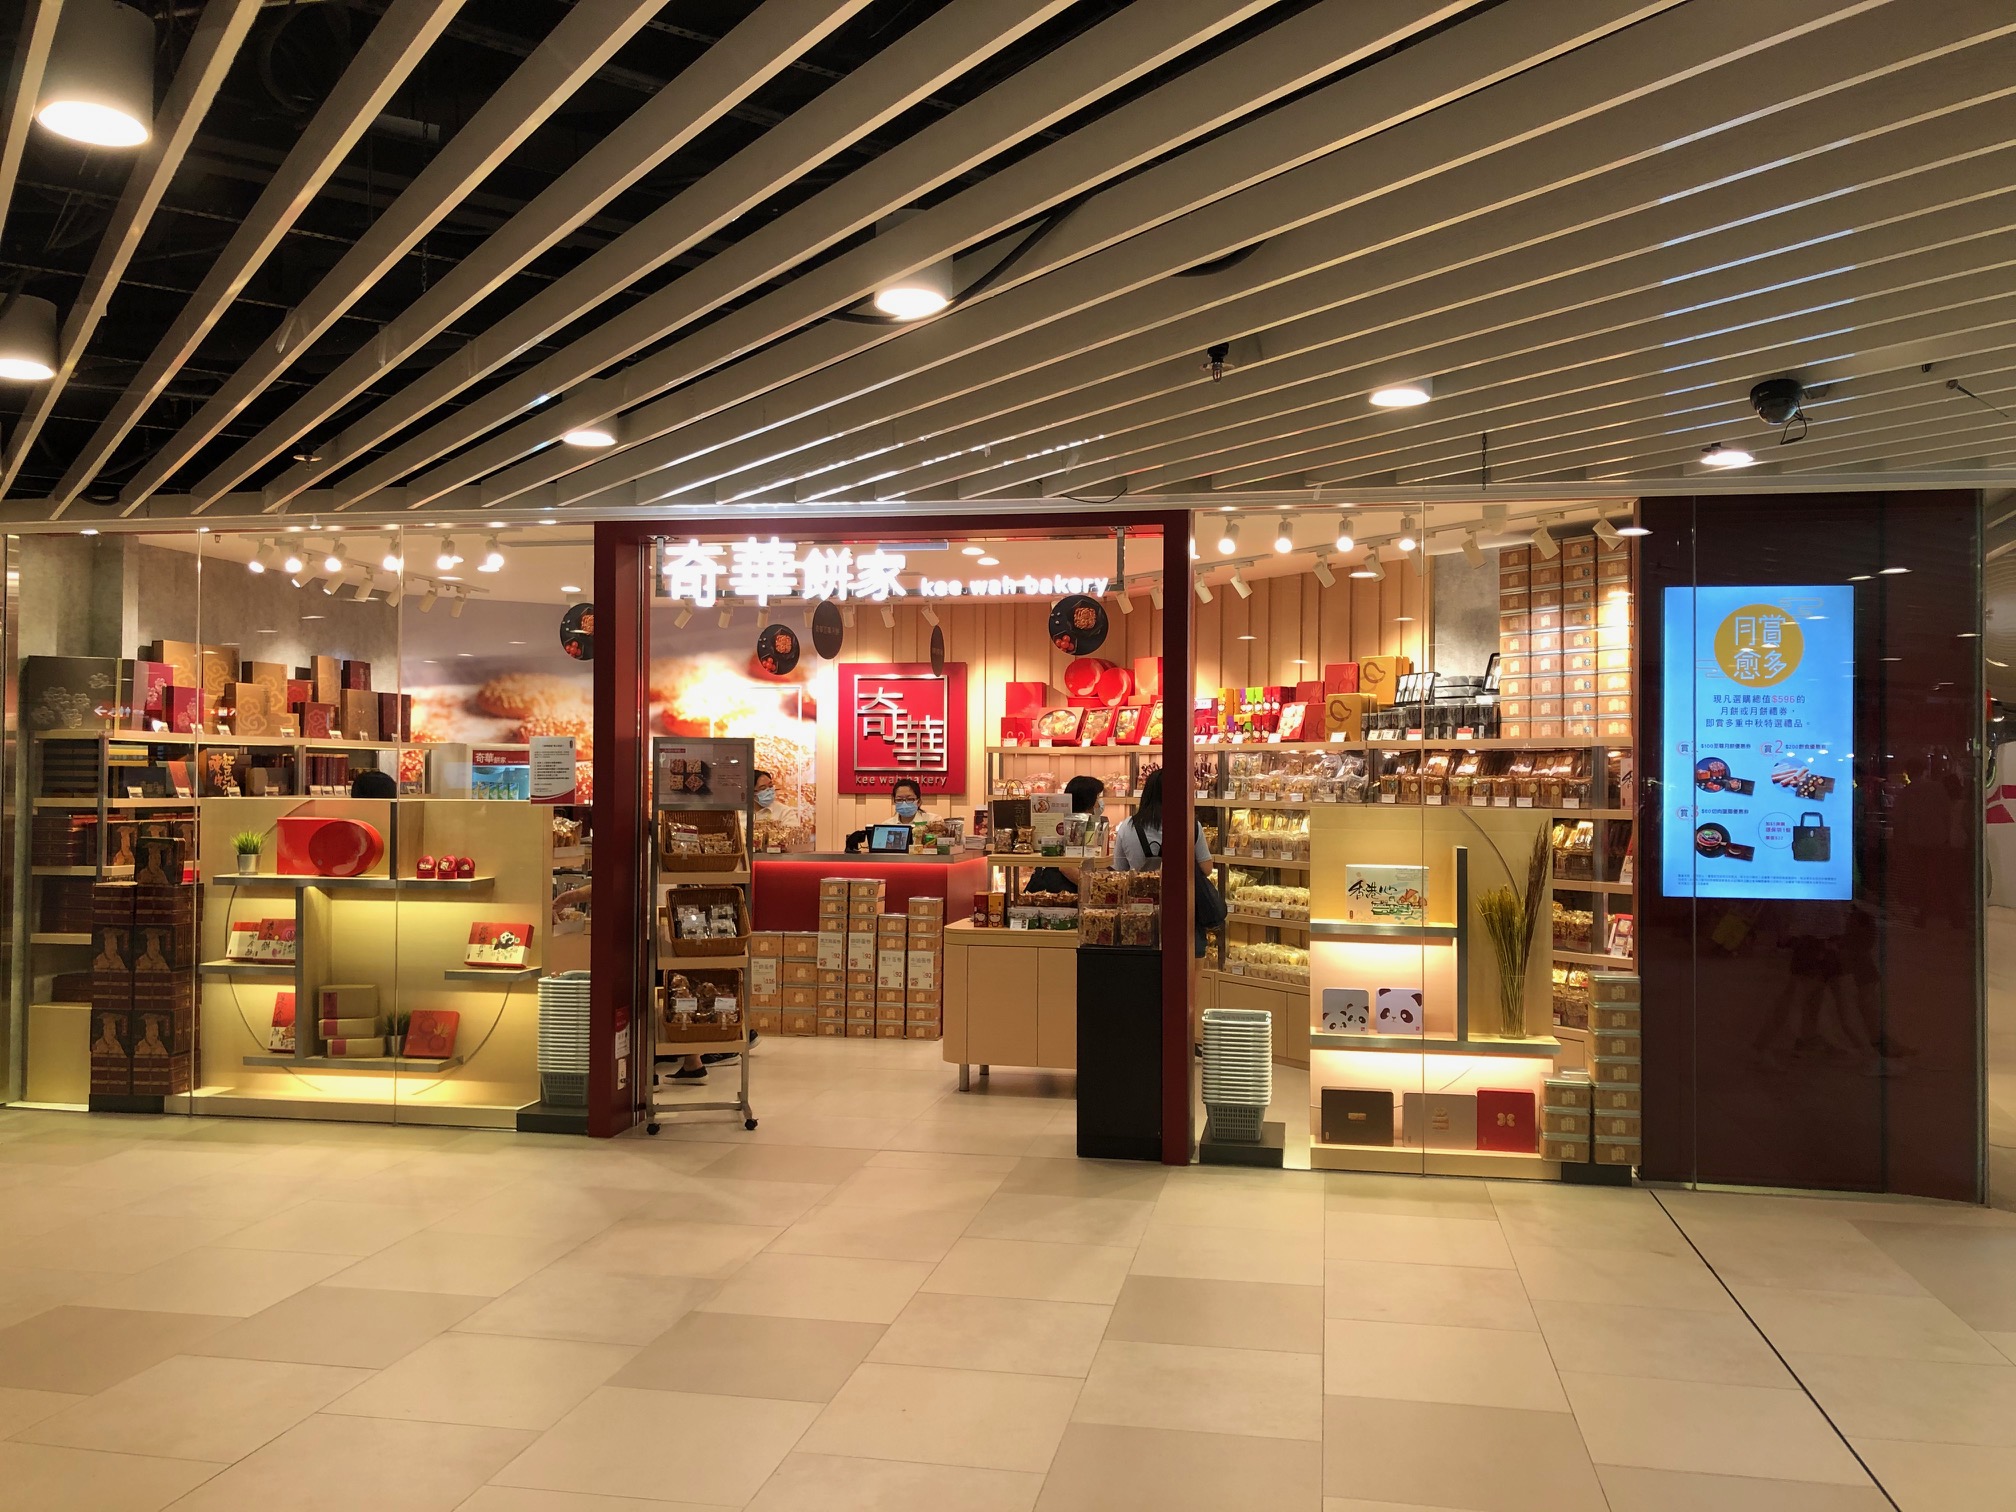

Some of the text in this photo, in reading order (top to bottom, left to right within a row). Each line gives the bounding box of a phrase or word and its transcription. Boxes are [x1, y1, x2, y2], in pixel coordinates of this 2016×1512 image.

[663, 536, 907, 607] 奇華餅家
[921, 575, 1109, 597] kee wah bakery
[856, 687, 946, 769] 奇華
[855, 775, 876, 784] kee
